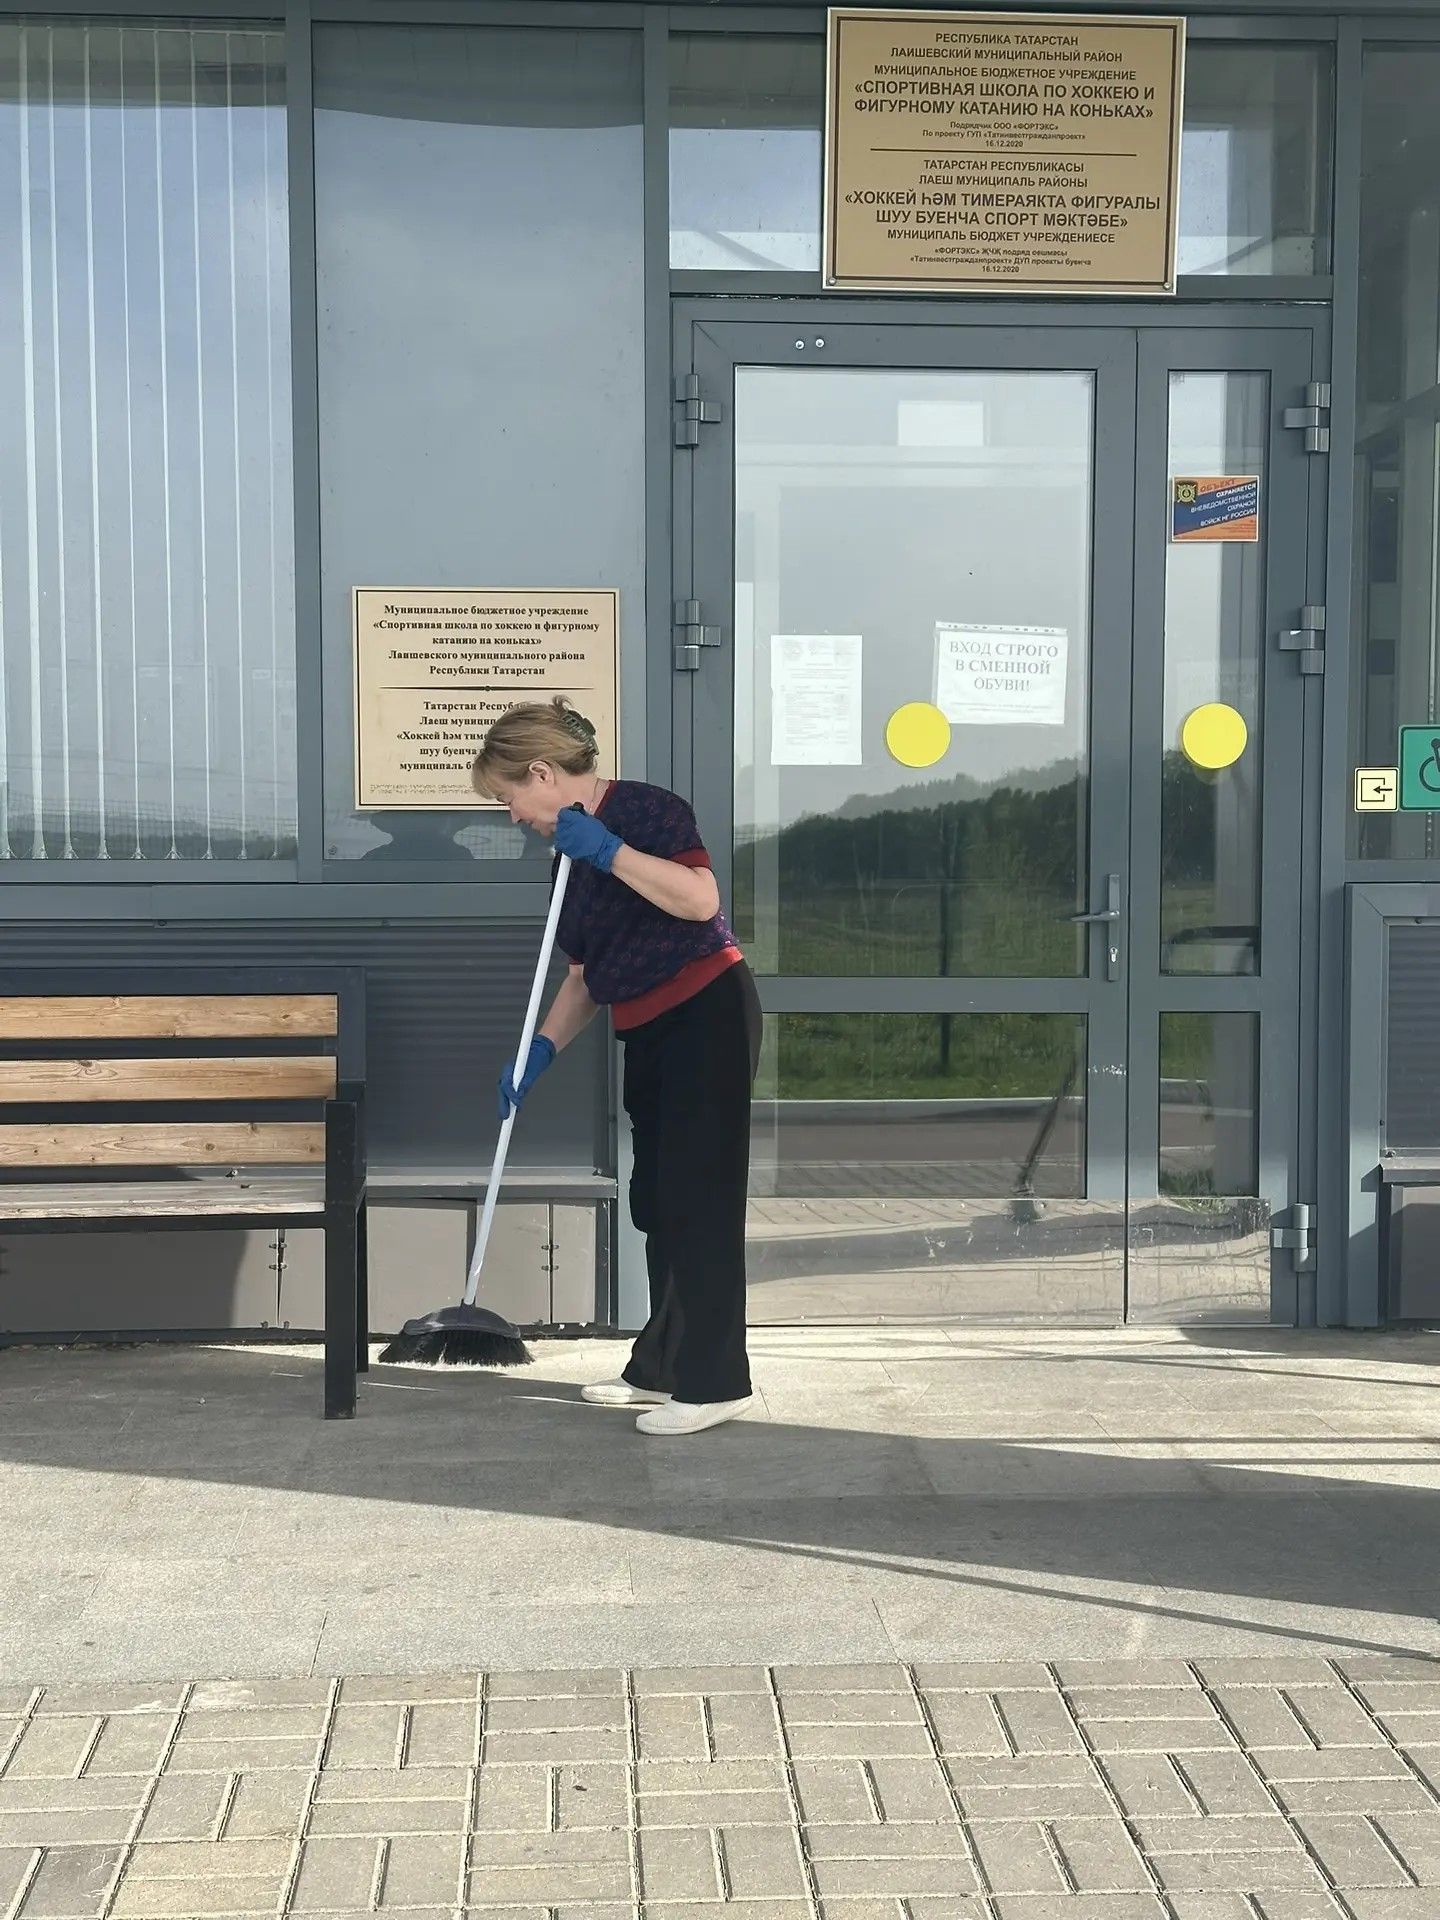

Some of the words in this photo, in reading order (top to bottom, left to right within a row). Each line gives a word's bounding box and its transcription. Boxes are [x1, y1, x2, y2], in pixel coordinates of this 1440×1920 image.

[935, 33, 1010, 45] РЕСПУБЛИКА
[1014, 35, 1078, 46] ТАТАРСТАН
[890, 47, 971, 59] ЛАИШЕВСКИЙ
[975, 49, 1081, 62] МУНИЦИПАЛЬНЫЙ
[1084, 49, 1122, 62] РАЙОН
[874, 64, 978, 78] МУНИЦИПАЛЬНОЕ
[981, 67, 1055, 80] БЮДЖЕТНОЕ
[1059, 68, 1136, 81] УЧРЕЖДЕНИЕ
[855, 80, 975, 95] «СПОРТИВНАЯ
[980, 83, 1040, 97] ШКОЛА
[1044, 84, 1066, 98] ПО
[1071, 85, 1139, 99] ХОККЕЮ
[1143, 87, 1155, 100] И
[854, 99, 955, 114] ФИГУРНОМУ
[960, 101, 1038, 116] КАТАНИЮ
[1043, 102, 1065, 116] НА
[1070, 103, 1154, 118] КОНЬКАХ»
[986, 140, 1023, 148] 16.12.2020
[924, 159, 988, 171] ТАТАРСТАН
[991, 160, 1084, 172] РЕСПУБЛИКАСЫ
[919, 175, 953, 186] ЛАЕШ
[956, 175, 1036, 188] МУНИЦИПАЛЬ
[1038, 175, 1088, 188] РАЙОНЫ
[845, 188, 916, 205] «ХОККЕЙ
[921, 193, 956, 206] ҺӘМ
[961, 194, 1067, 208] ТИМЕРАЯКТА
[1071, 195, 1160, 210] ФИГУРАЛЫ
[876, 211, 910, 224] ШУУ
[915, 212, 979, 225] БУЕНЧА
[985, 212, 1038, 227] СПОРТ
[1044, 214, 1128, 228] МӘКТӘБЕ»
[887, 229, 967, 242] МУНИЦИПАЛЬ
[970, 230, 1021, 242] БЮДЖЕТ
[1023, 231, 1115, 244] УЧРЕЖДЕНИЕСЕ
[1216, 483, 1256, 498] ОХРАНЯЕТСЯ
[384, 605, 469, 615] Муниципальное
[471, 605, 527, 615] бюджетное
[528, 606, 589, 617] учреждение
[373, 620, 442, 631] «Спортивная
[445, 622, 478, 630] школа
[480, 622, 493, 630] по
[495, 622, 532, 630] хоккею
[534, 622, 541, 630] и
[543, 621, 600, 633] фигурному
[432, 636, 477, 644] катанию
[479, 636, 492, 644] на
[494, 636, 542, 645] коньках»
[388, 650, 458, 661] Лаишевского
[460, 652, 547, 662] муниципального
[549, 651, 585, 662] района
[950, 641, 992, 656] ВХОД
[995, 643, 1059, 658] СТРОГО
[429, 665, 489, 676] Республики
[492, 666, 545, 676] Татарстан
[955, 659, 965, 671] В
[969, 659, 1051, 675] СМЕННОЙ
[974, 677, 1032, 691] ОБУВИ!
[423, 702, 477, 712] Татарстан
[420, 716, 448, 725] Лаеш
[450, 717, 496, 727] муницип
[396, 730, 440, 740] «Хоккей
[442, 731, 462, 740] һәм
[420, 747, 440, 756] шуу
[442, 746, 477, 756] буенча
[399, 762, 464, 771] муниципаль
